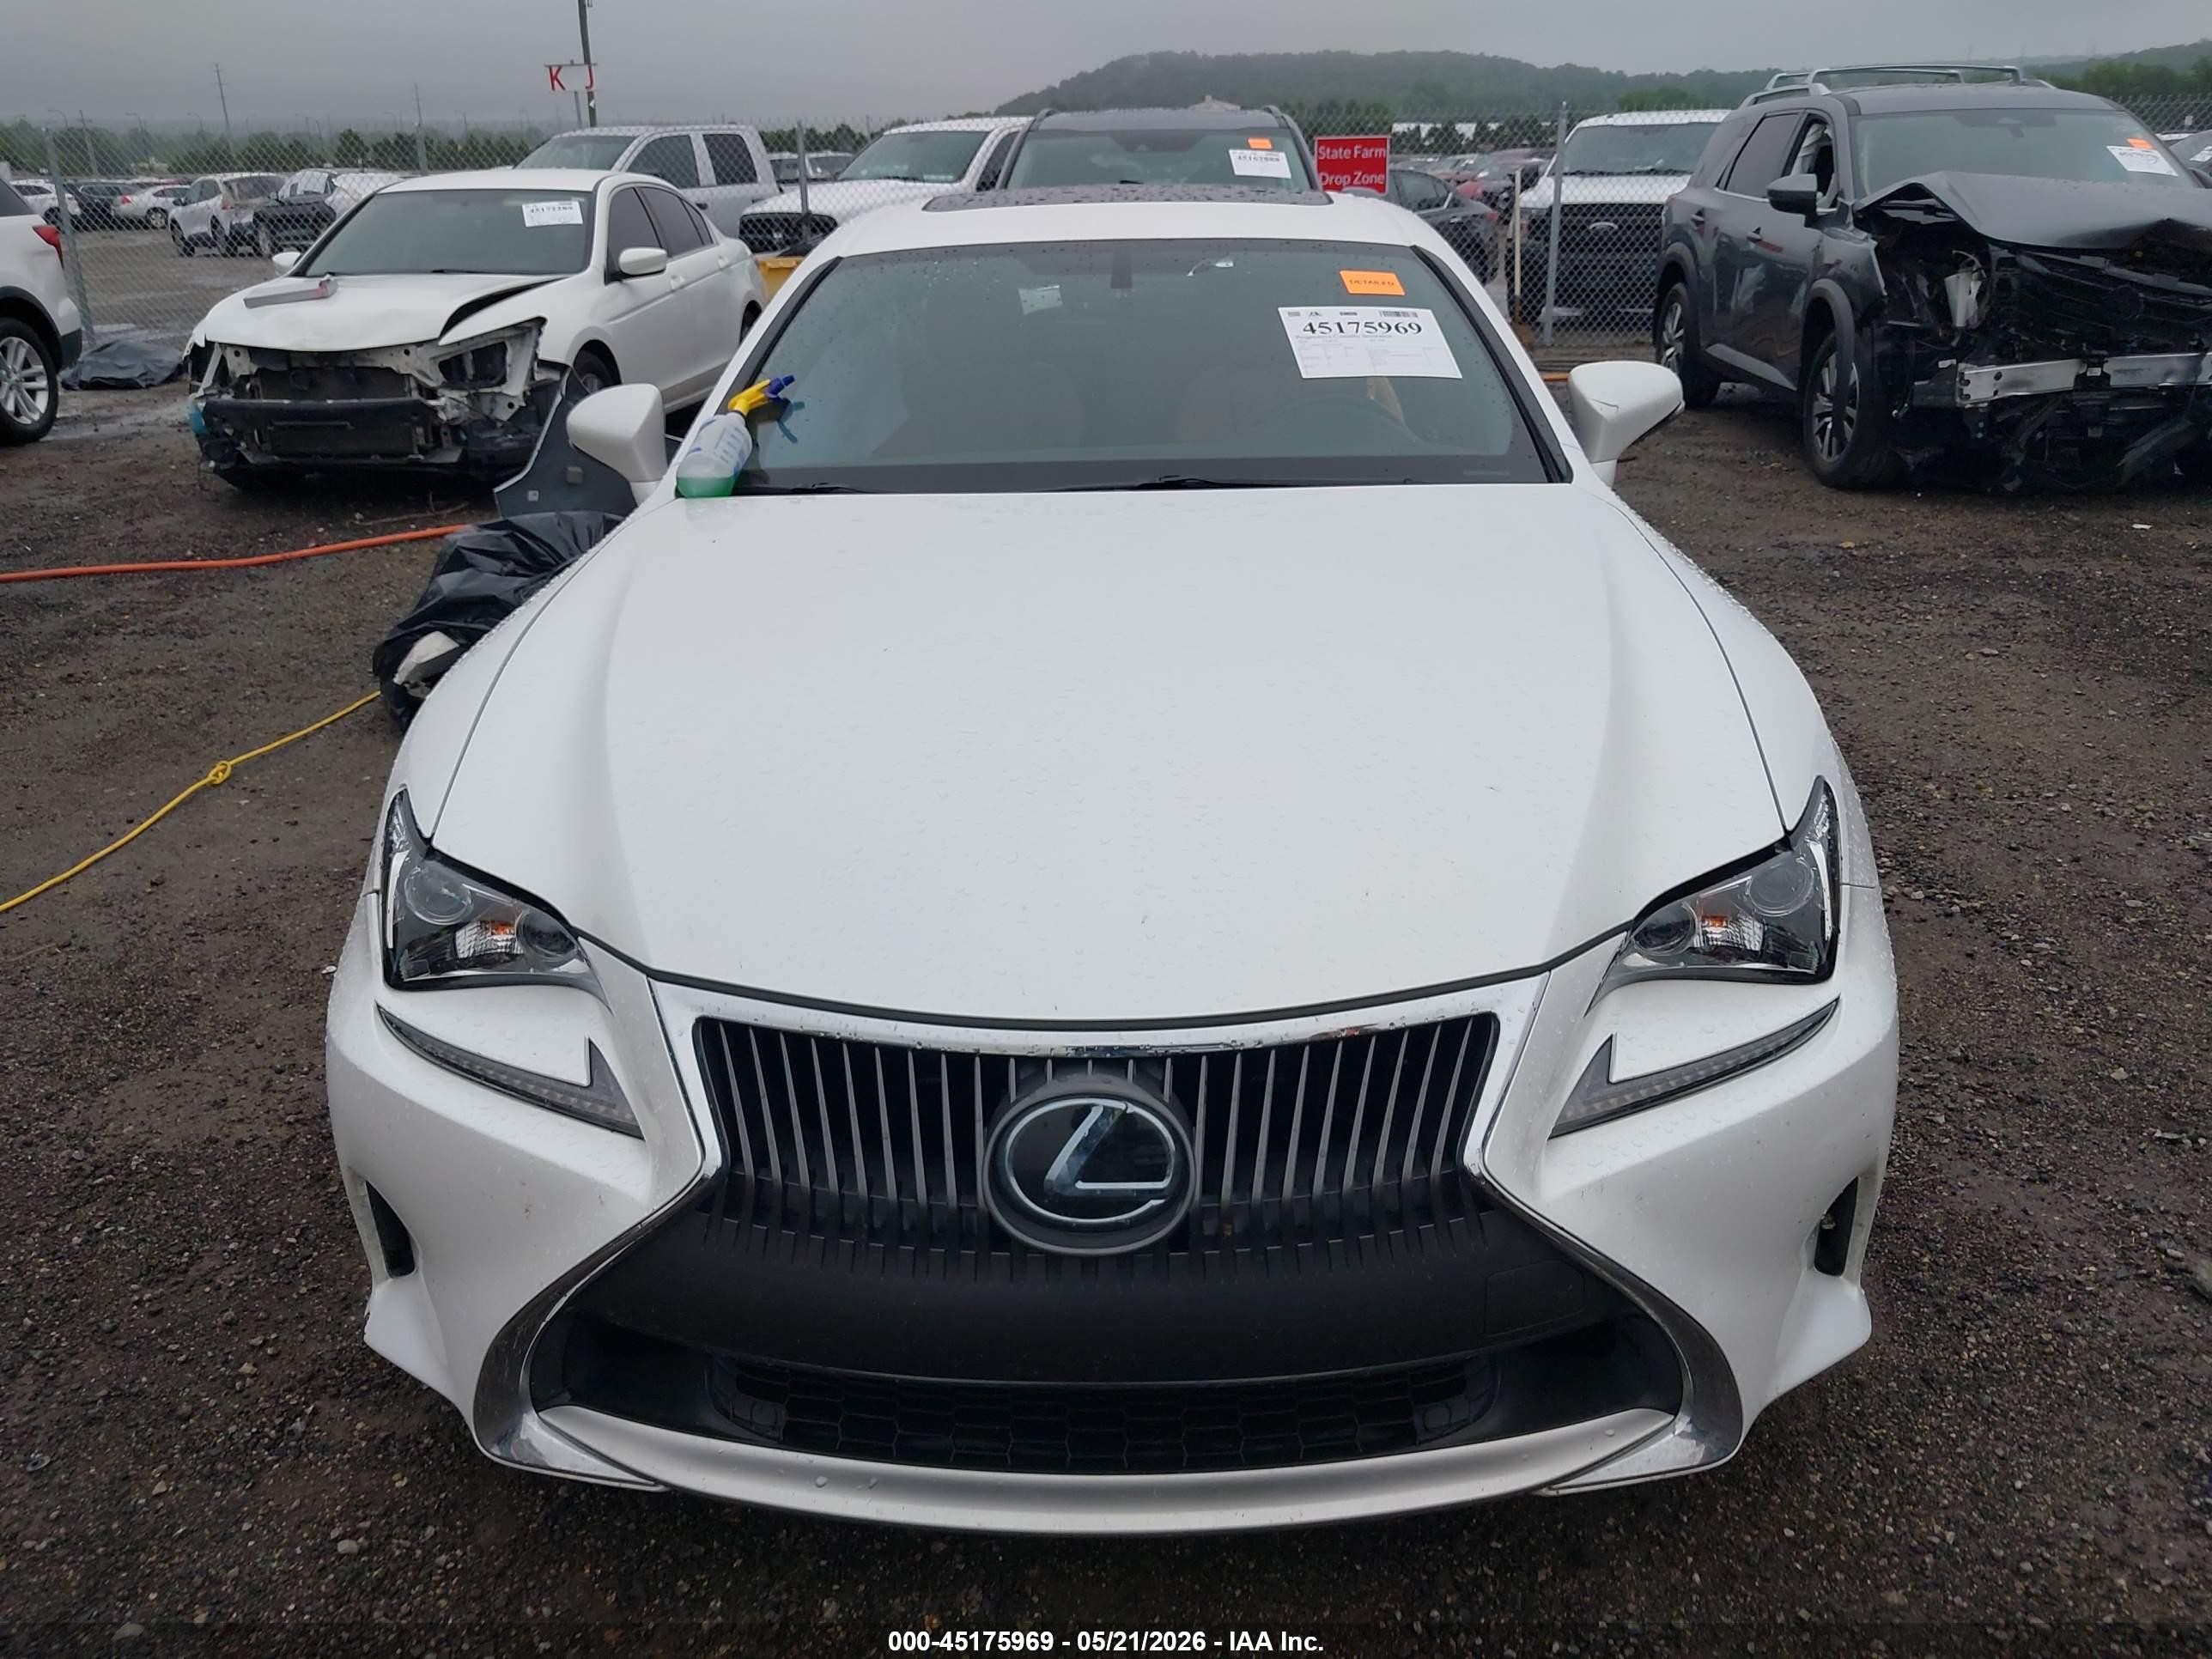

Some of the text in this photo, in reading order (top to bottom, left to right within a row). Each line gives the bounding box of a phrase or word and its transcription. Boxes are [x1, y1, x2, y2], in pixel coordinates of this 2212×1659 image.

[549, 64, 594, 91] K J
[1318, 144, 1386, 160] State Farm
[1319, 171, 1385, 186] Drop Zone
[1303, 321, 1422, 334] 45175969
